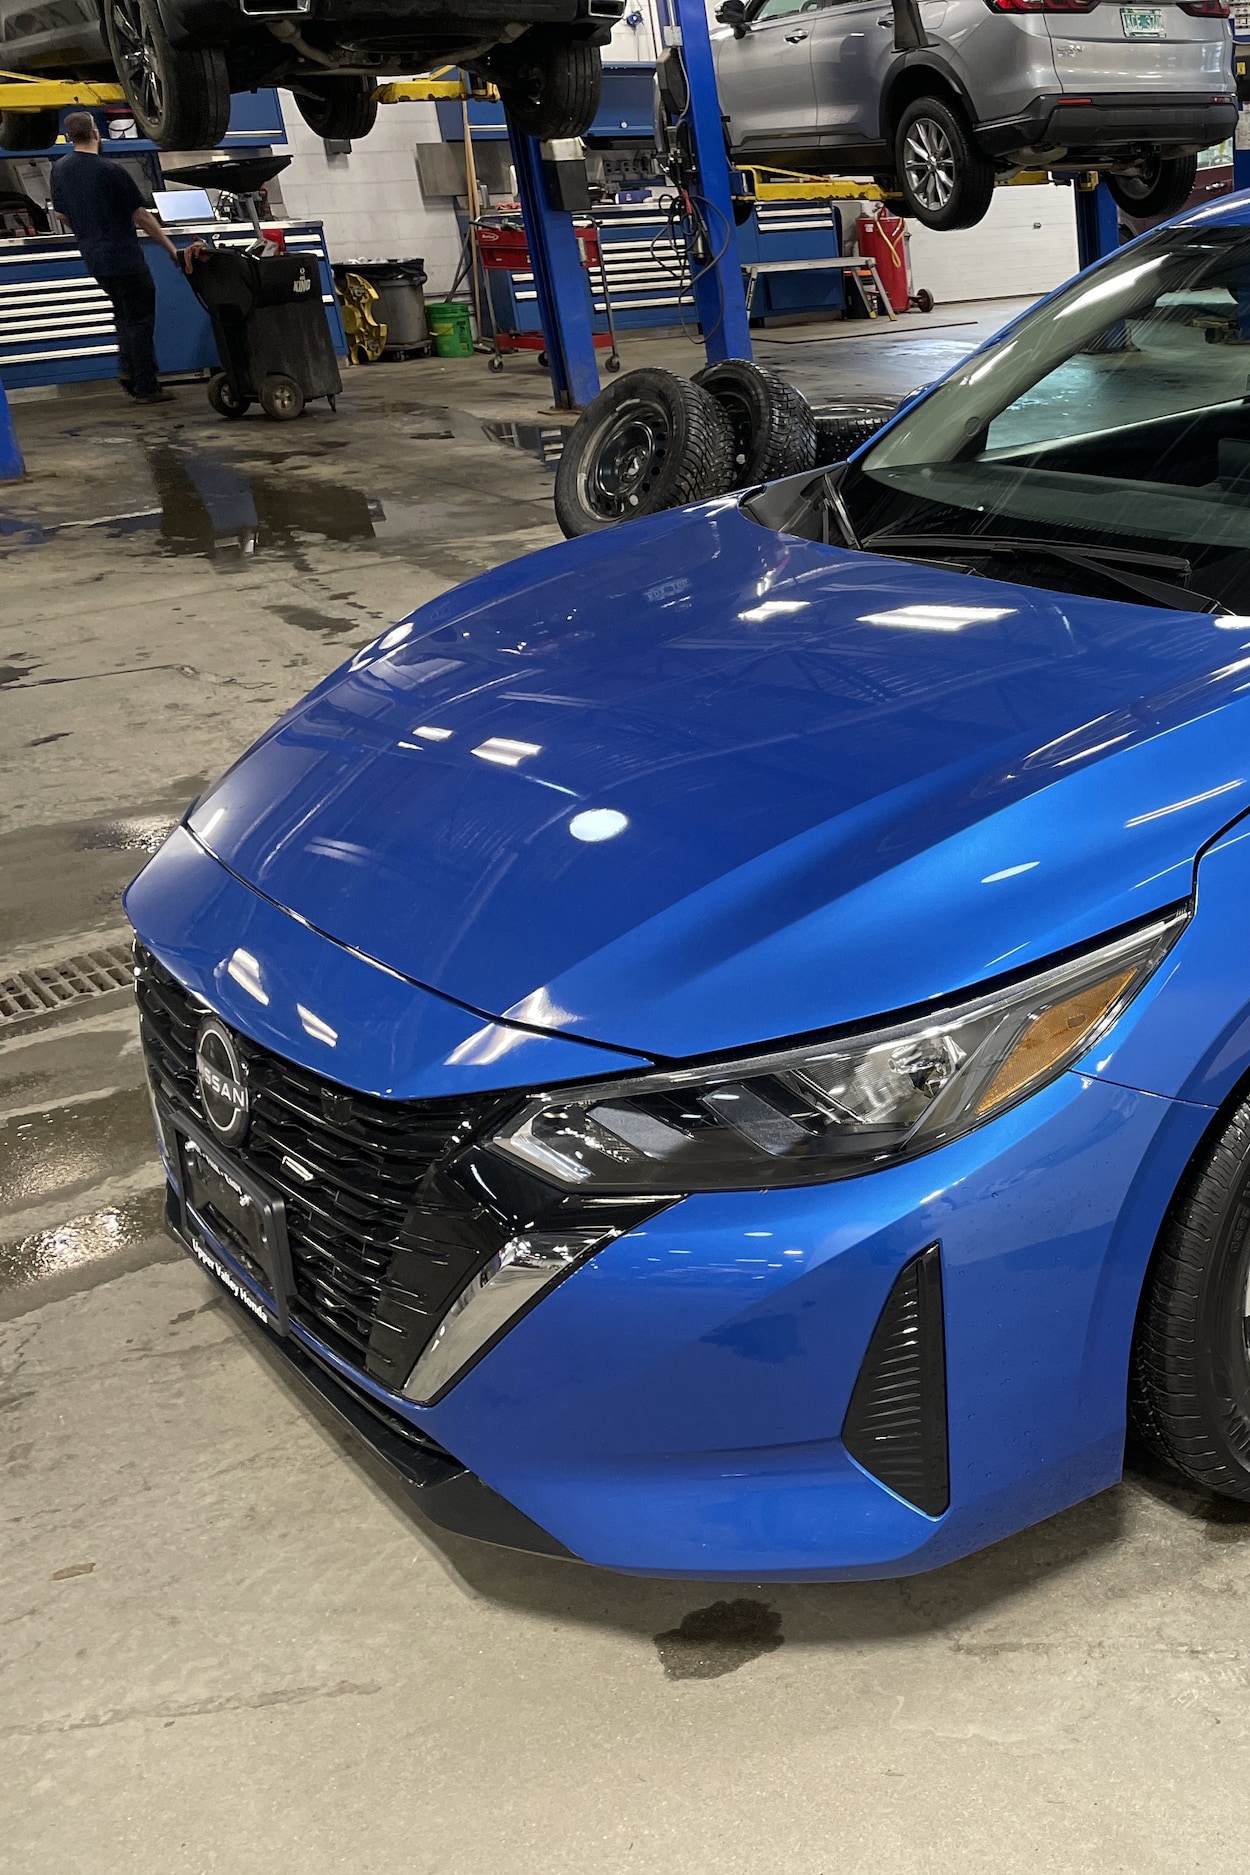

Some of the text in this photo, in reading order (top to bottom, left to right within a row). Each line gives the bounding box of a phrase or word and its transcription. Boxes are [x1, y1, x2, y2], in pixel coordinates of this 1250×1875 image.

[192, 1238, 268, 1324] Upper Valley Honda
